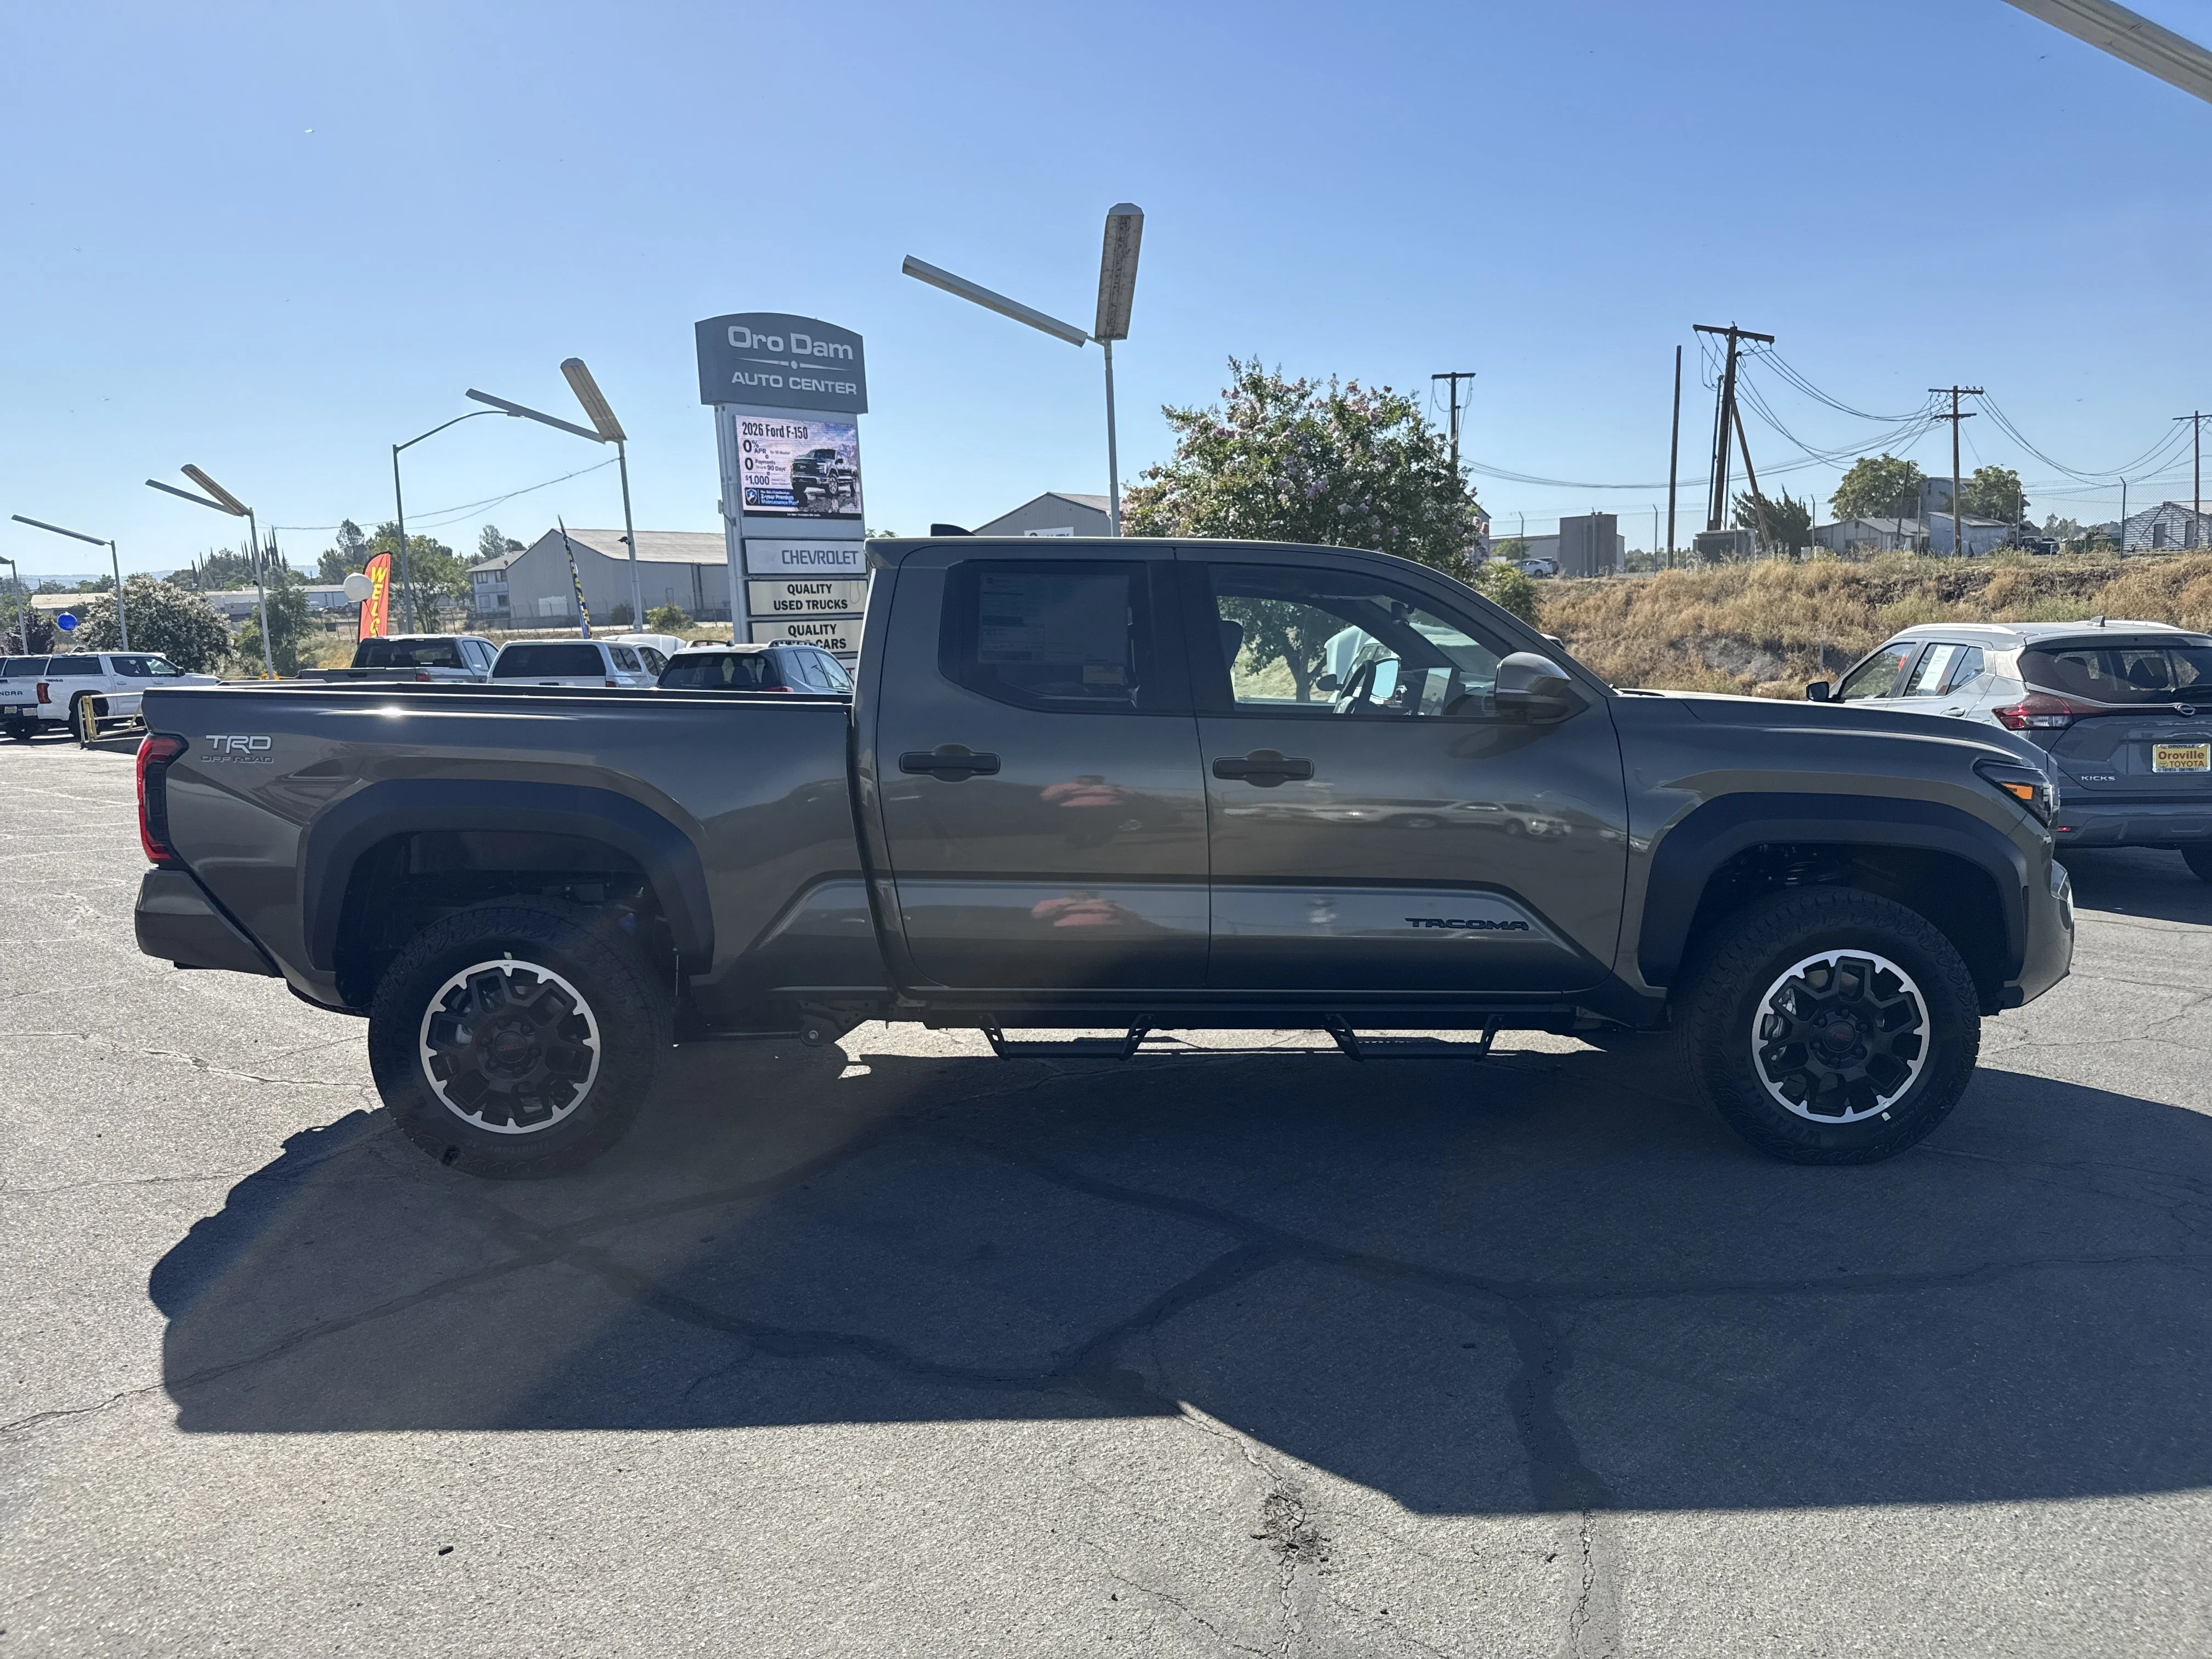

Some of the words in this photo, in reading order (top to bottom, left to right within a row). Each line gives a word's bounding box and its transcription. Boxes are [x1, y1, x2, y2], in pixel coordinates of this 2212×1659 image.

[727, 325, 785, 352] Oro
[790, 332, 853, 360] Dam
[731, 371, 783, 388] AUTO
[789, 377, 857, 395] CENTER
[742, 422, 764, 436] 2026
[765, 424, 785, 438] Ford
[786, 425, 809, 439] F-150
[744, 457, 754, 471] 0
[745, 475, 770, 486] $1,000
[781, 550, 859, 565] CHEVROLET
[787, 584, 832, 596] QUALITY
[370, 566, 388, 637] WELC
[774, 600, 803, 611] USED
[805, 599, 848, 610] TRUCKS
[788, 624, 837, 638] QUALITY
[816, 638, 847, 650] CARS
[206, 735, 272, 754] TRD
[201, 755, 232, 763] OFF
[233, 755, 274, 764] ROAD
[2158, 751, 2204, 760] Oroville
[1405, 918, 1529, 930] TACOMA
